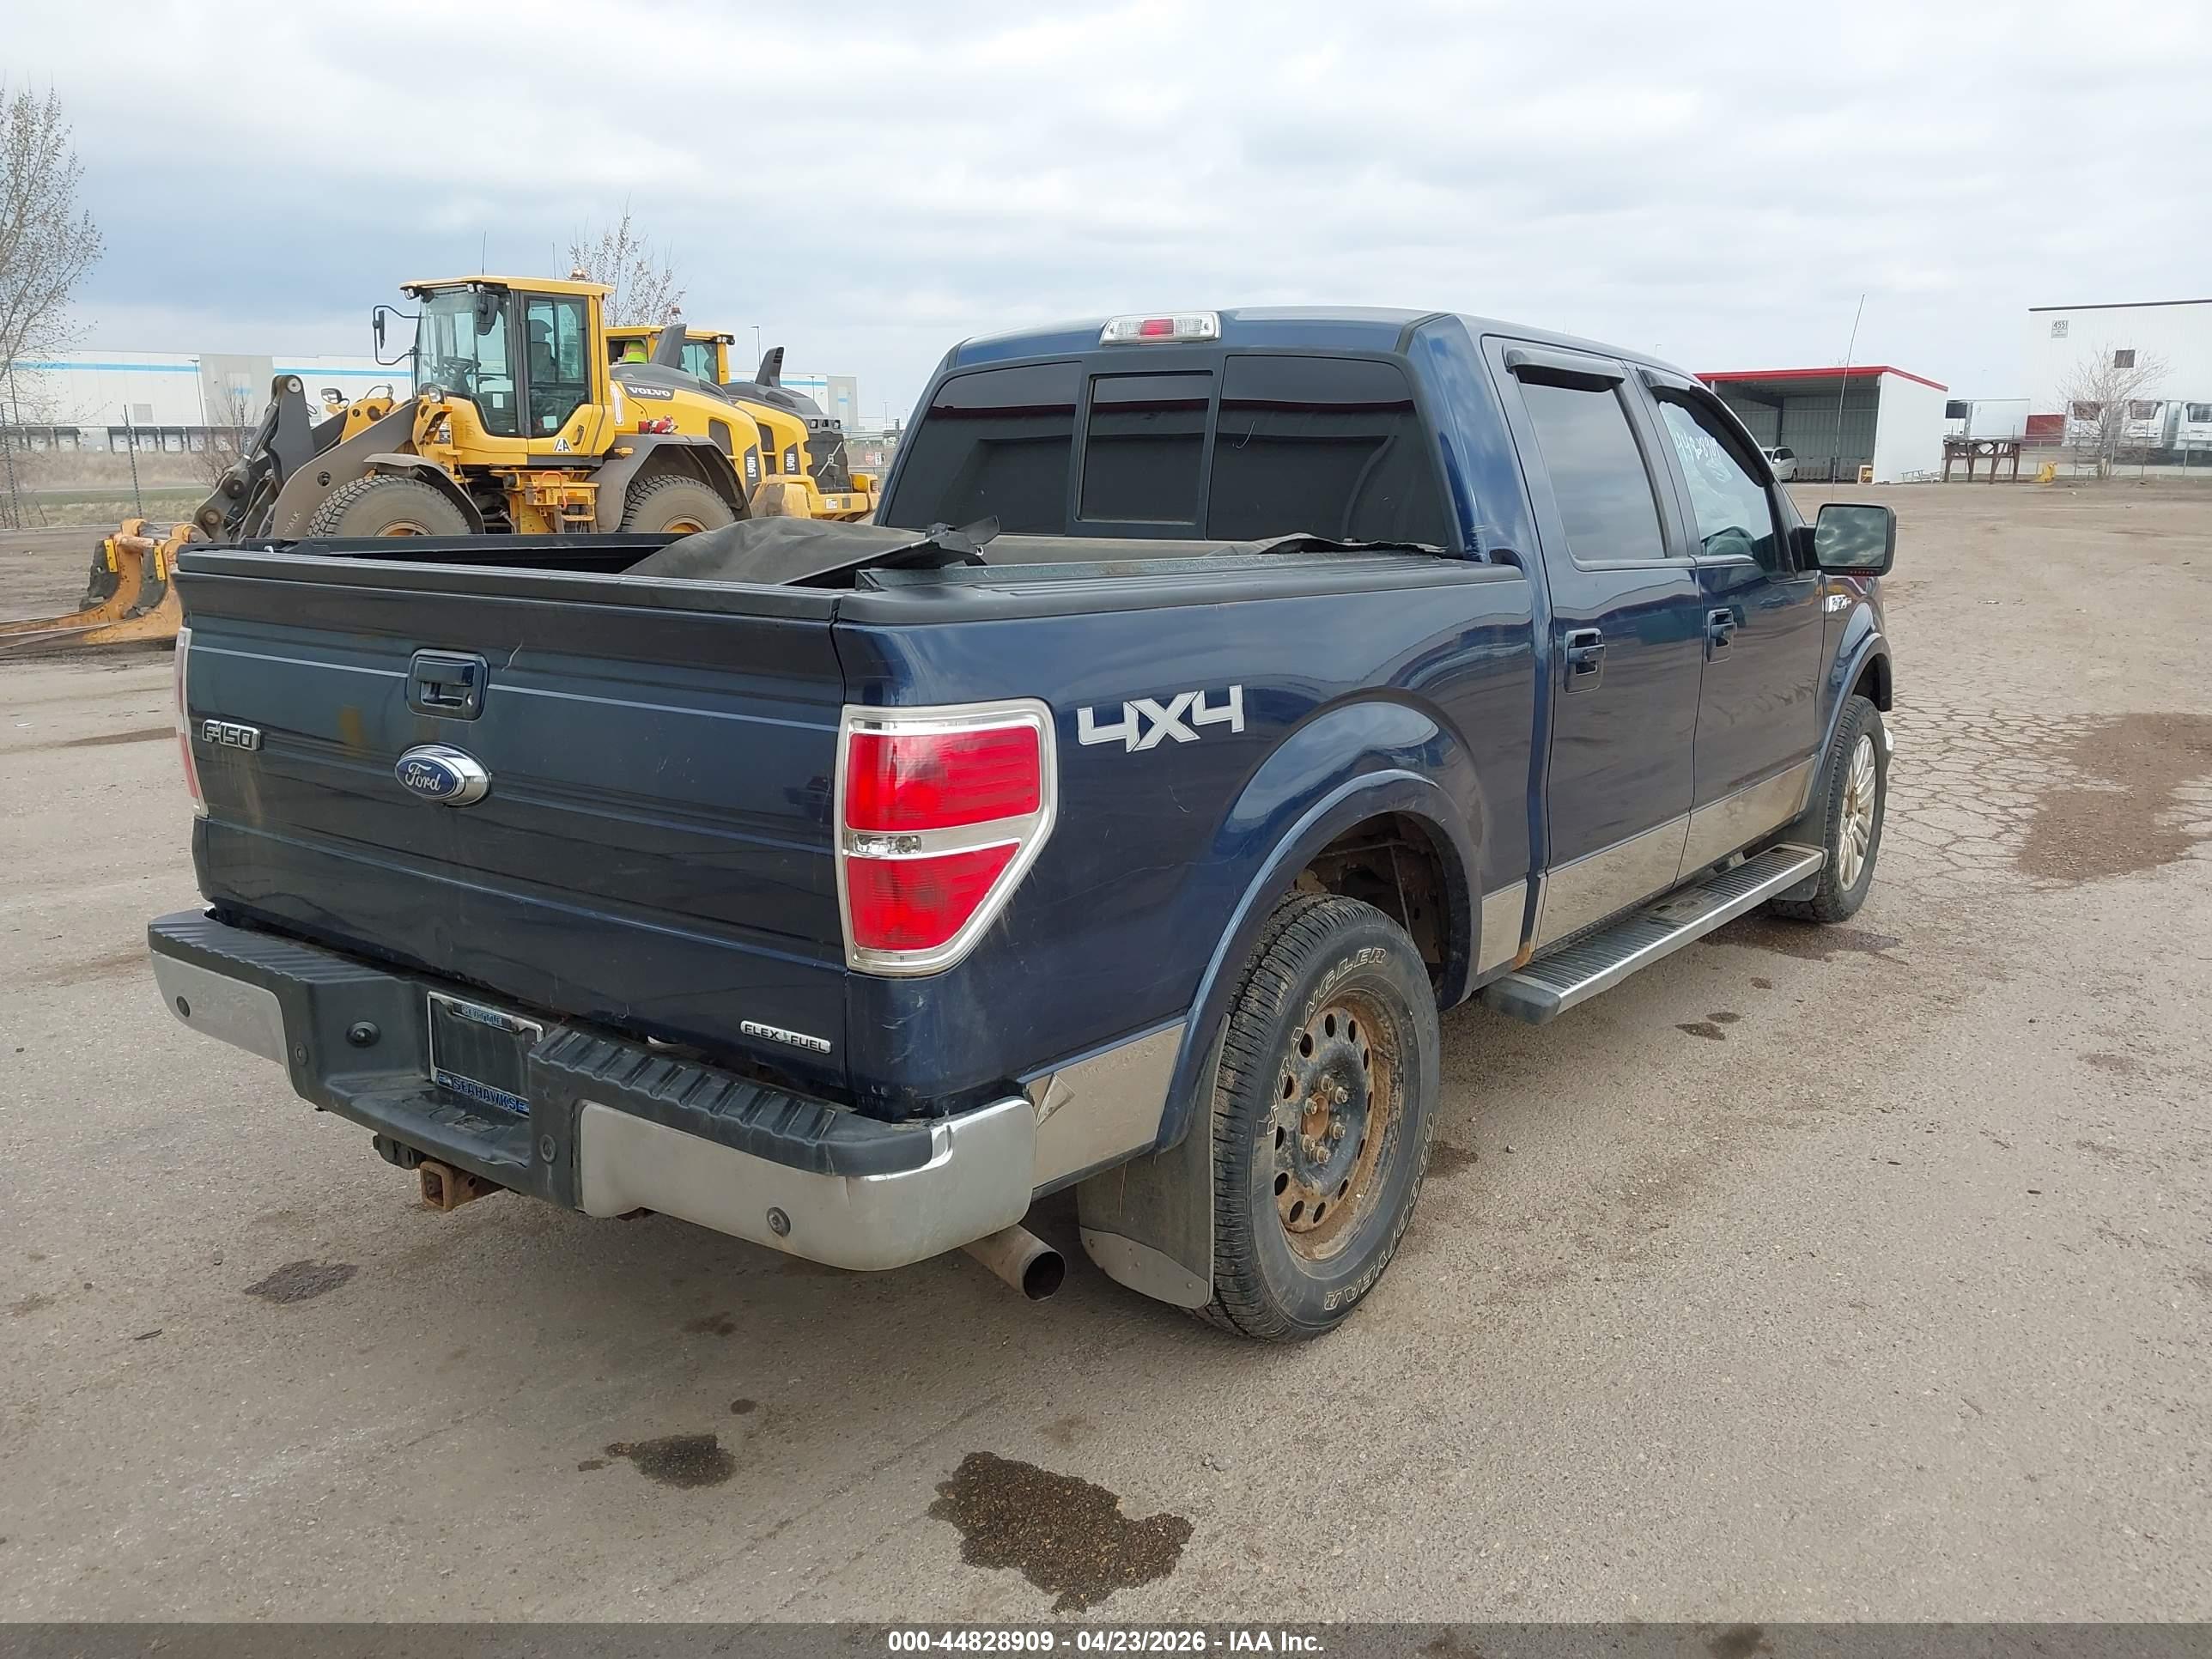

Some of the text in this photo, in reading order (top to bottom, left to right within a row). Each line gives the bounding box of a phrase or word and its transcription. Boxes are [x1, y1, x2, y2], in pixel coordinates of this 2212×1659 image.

[627, 386, 671, 398] VOLVO
[746, 456, 757, 477] L90H
[786, 453, 796, 471] L90H
[1076, 684, 1244, 753] 4X4
[405, 762, 441, 791] Ford
[744, 1024, 826, 1052] FLEX FUEL
[1267, 947, 1387, 1135] WRANGLER
[452, 1076, 517, 1111] SEAHAWKS
[1323, 1112, 1435, 1310] GOODYEAR
